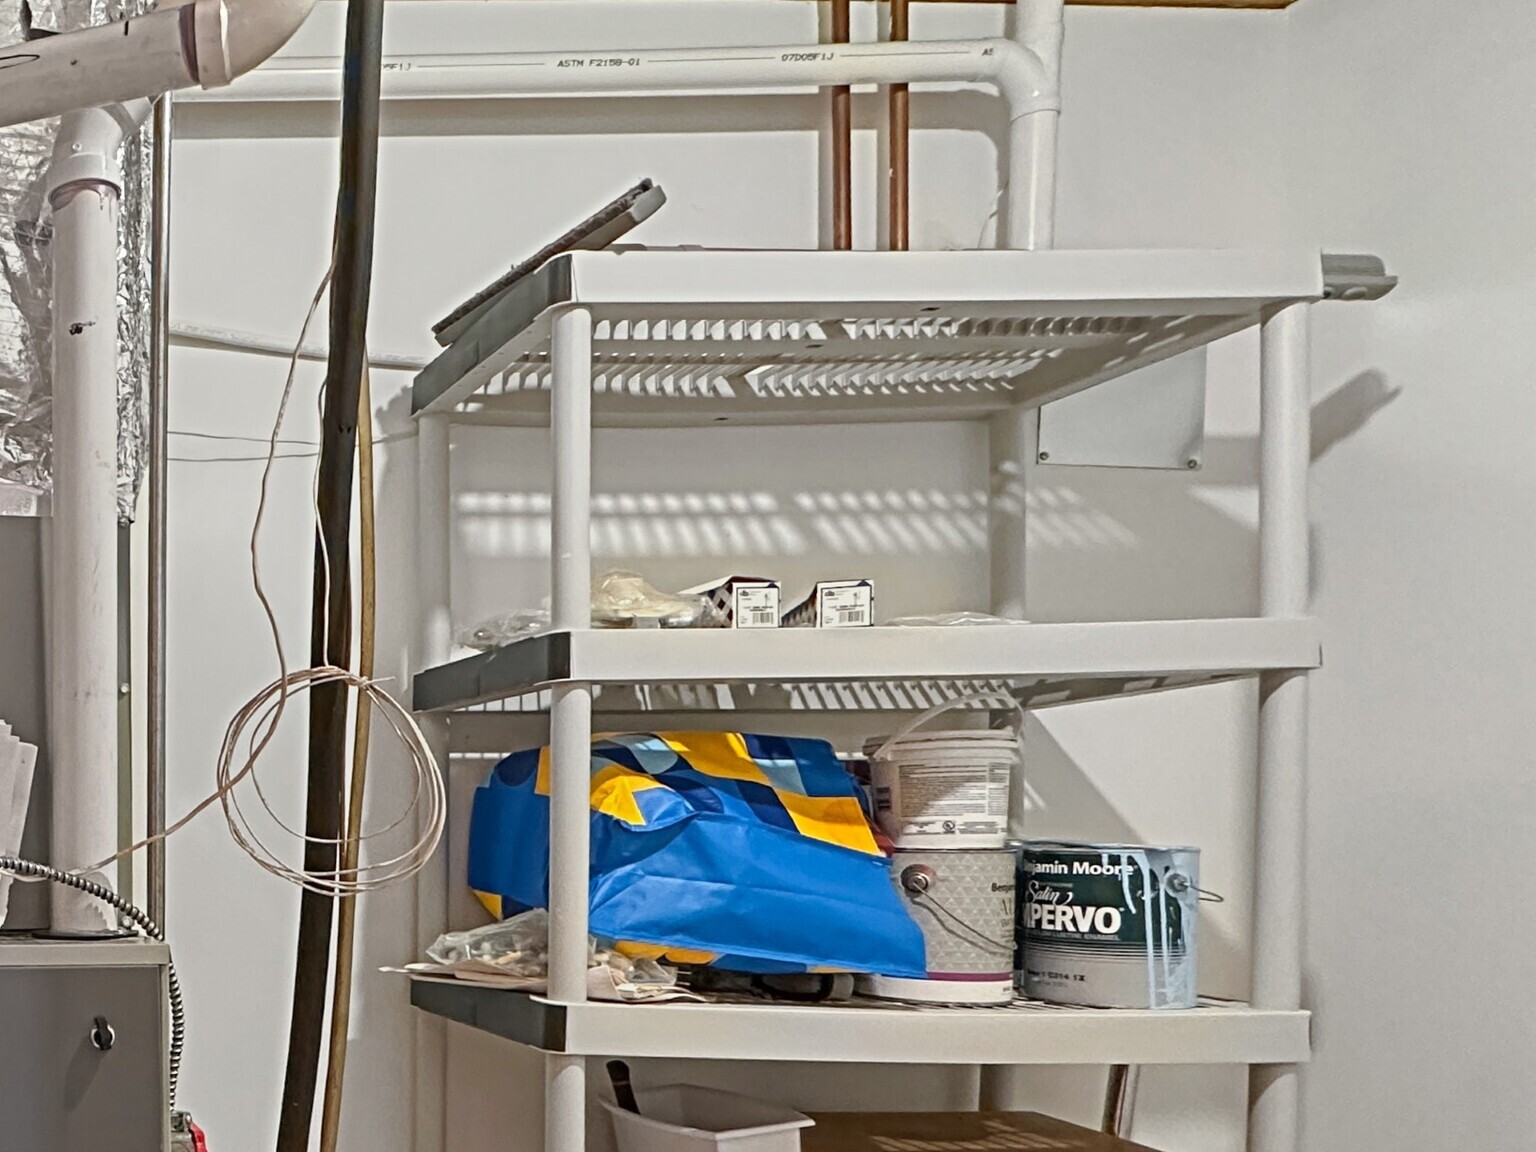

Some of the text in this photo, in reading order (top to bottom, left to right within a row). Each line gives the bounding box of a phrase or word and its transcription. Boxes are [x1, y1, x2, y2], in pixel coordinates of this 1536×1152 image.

[557, 59, 584, 67] ASTM
[1072, 861, 1134, 876] Moore
[1026, 879, 1073, 906] Satin
